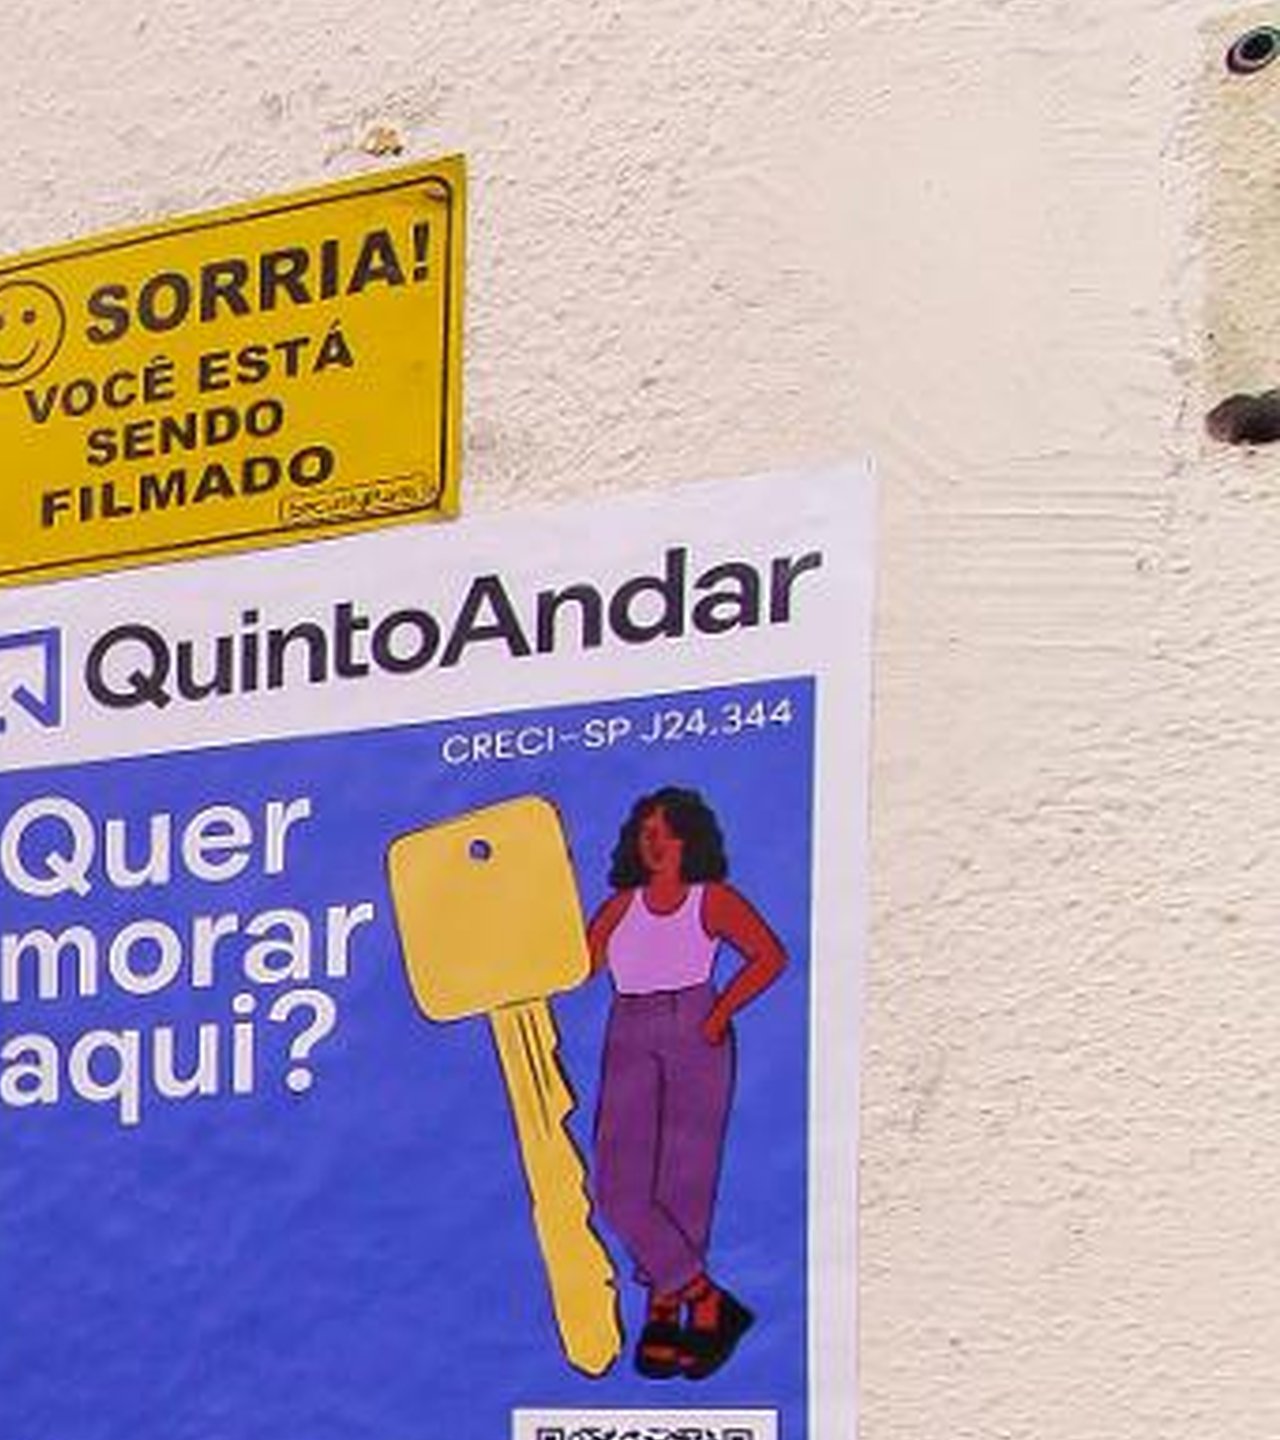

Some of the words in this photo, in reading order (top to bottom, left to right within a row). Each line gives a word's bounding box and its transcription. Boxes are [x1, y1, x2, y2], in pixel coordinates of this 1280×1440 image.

[86, 222, 432, 344] SORRIA!
[23, 357, 176, 424] VOCÊ
[198, 319, 355, 395] ESTÁ
[87, 400, 285, 466] SENDO
[41, 446, 335, 527] FILMADO
[84, 548, 824, 709] QuintoAndar
[441, 717, 630, 766] CRECI-SP
[641, 698, 793, 744] J24.344
[0, 796, 310, 897] Quer
[0, 900, 375, 1003] morar
